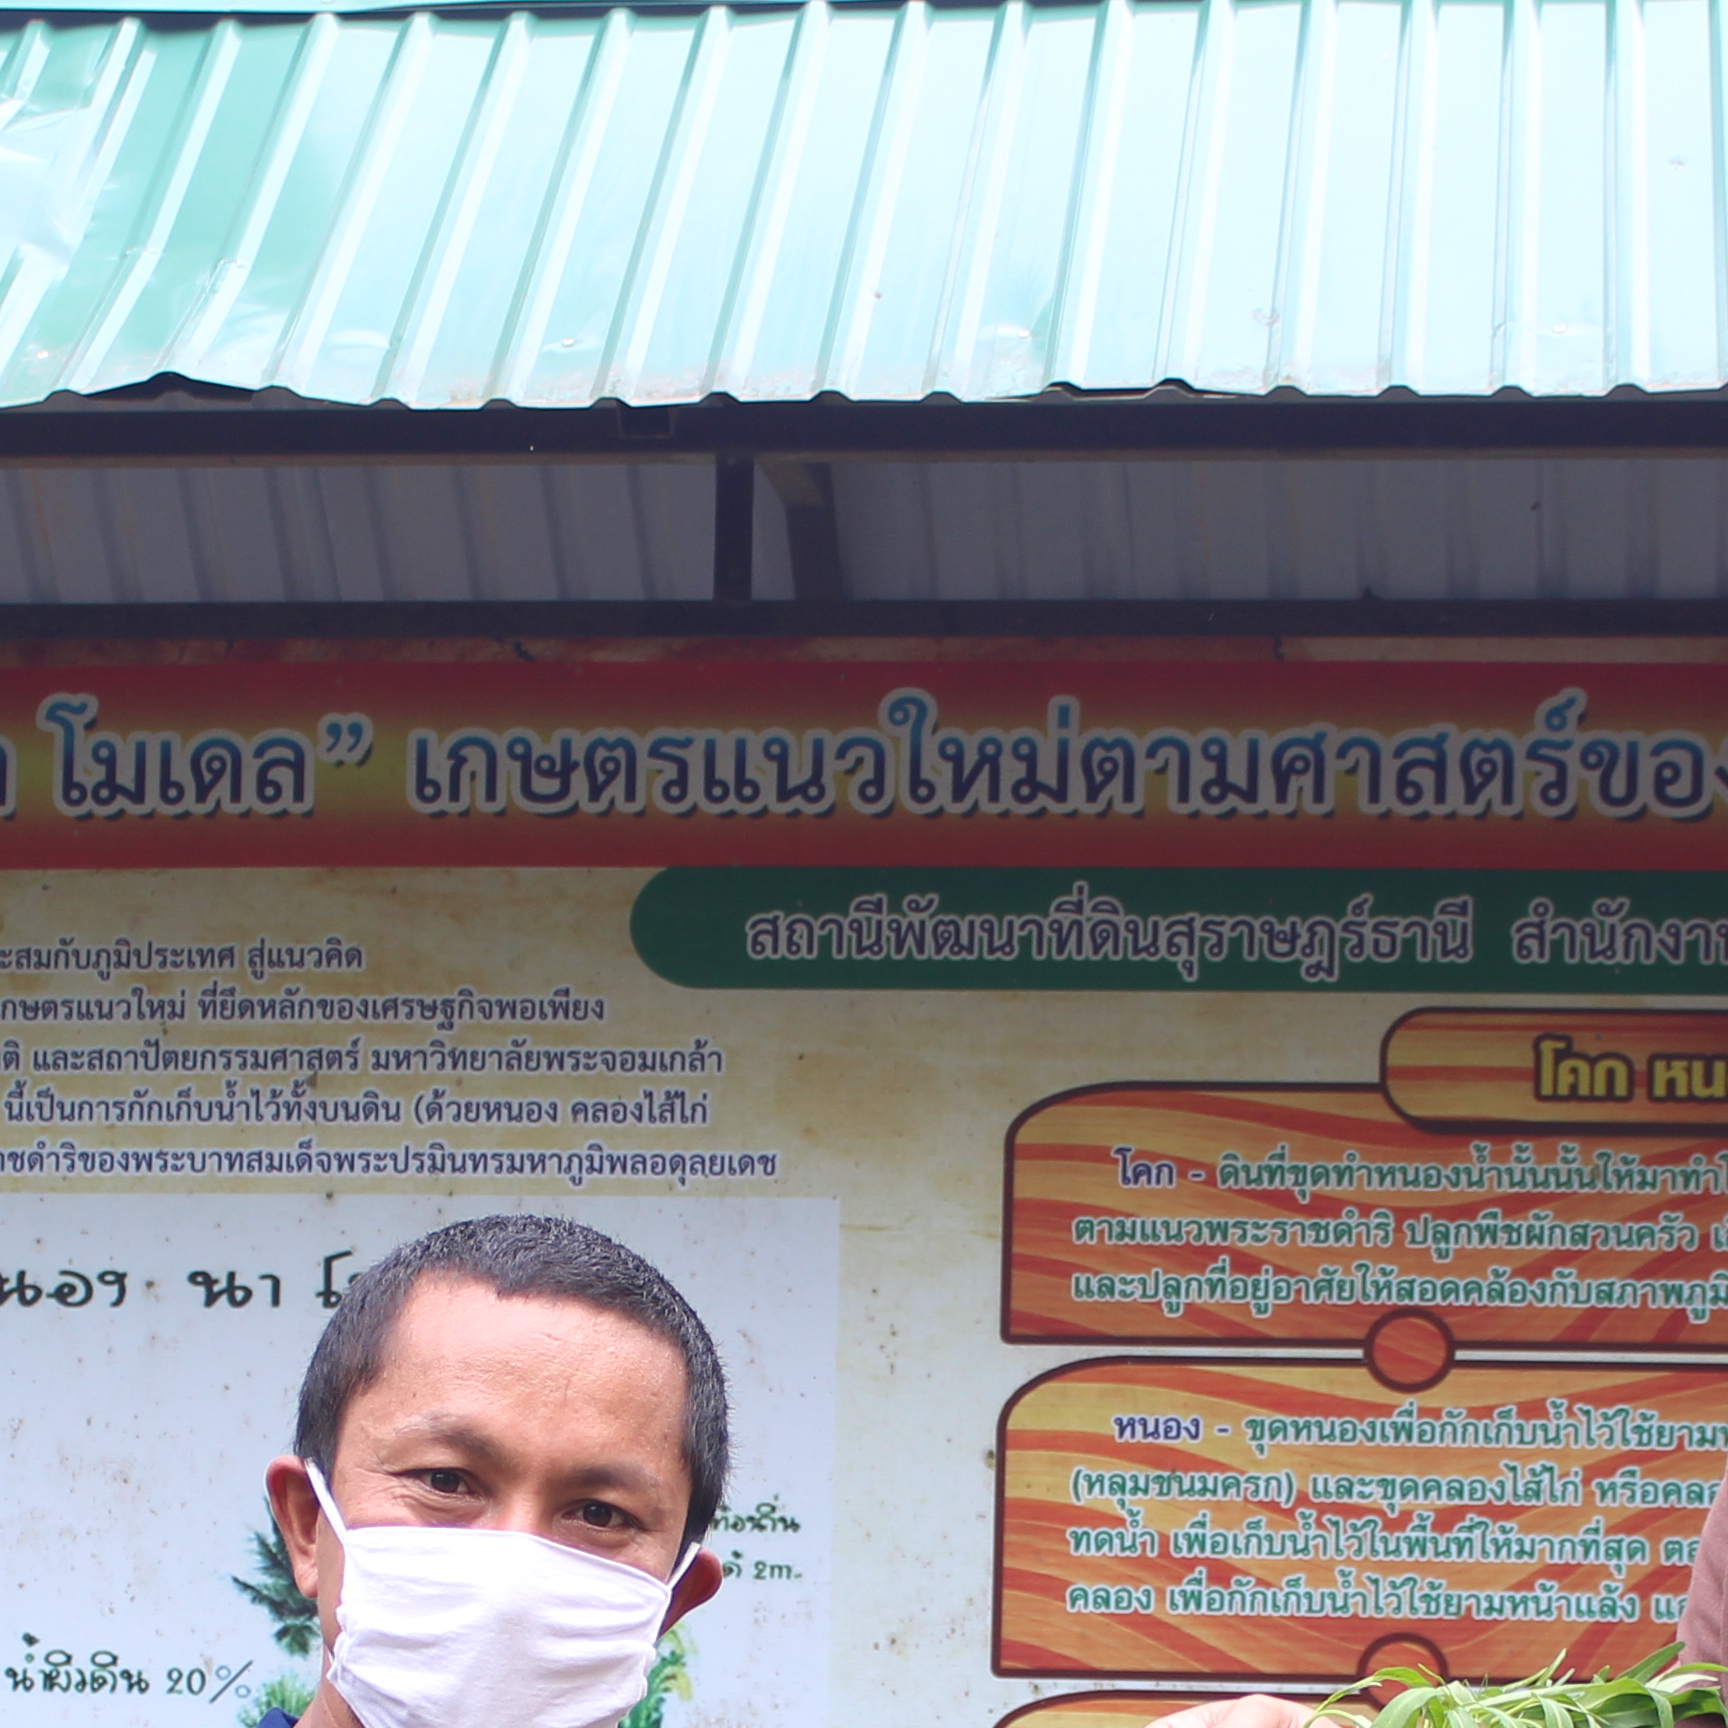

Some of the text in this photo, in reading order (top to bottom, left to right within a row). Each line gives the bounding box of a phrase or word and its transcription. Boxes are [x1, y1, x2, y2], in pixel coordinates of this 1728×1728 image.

[36, 692, 374, 816] โมเดล”
[744, 882, 1474, 980] สถานีพัฒนาที่ดินสุราษฎร์ธานี
[248, 941, 364, 981] สู่แนวคิด
[199, 985, 605, 1030] ที่ยึดหลักของเศรษฐกิจพอเพียง
[32, 1037, 362, 1075] และสถาปัตยกรรมศาสตร์
[370, 1041, 723, 1076] มหาวิทยาลัยพระจอมเกล้า
[1534, 1036, 1629, 1104] โคก
[3, 1080, 402, 1125] นี้เป็นการกักเก็บน้ำไว้ทั้งบนดิน
[413, 1088, 558, 1126] (ด้วยหนอง
[570, 1088, 709, 1125] คลองไส้ไก่
[1111, 1146, 1176, 1190] โคก
[1072, 1214, 1395, 1251] ตามแนวพระราชดำริ
[1406, 1214, 1696, 1263] ปลูกพืชผักสวนครัว
[189, 1268, 282, 1309] นา
[1113, 1413, 1201, 1443] หนอง
[1309, 1462, 1582, 1516] และขุดคลองไส้ไก่
[1068, 1510, 1157, 1558] ทดน้ำ
[1067, 1582, 1153, 1614] คลอง
[166, 1659, 253, 1704] 20%
